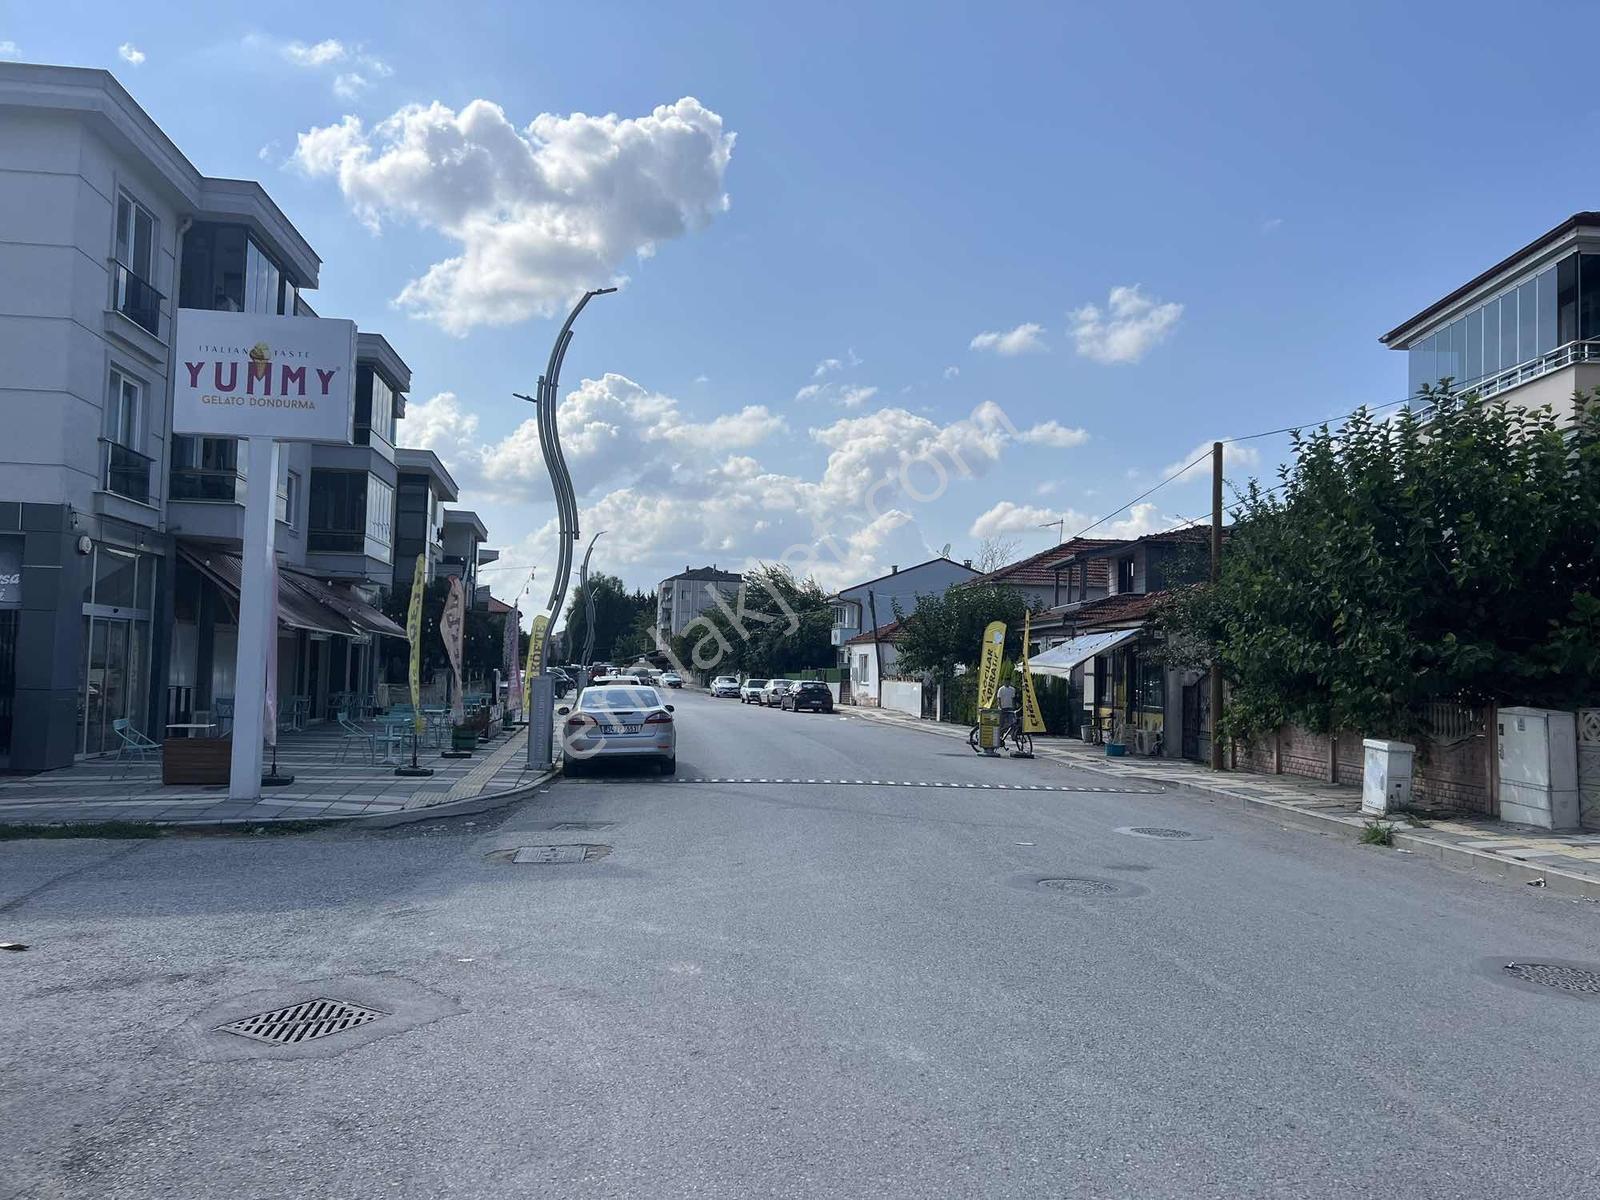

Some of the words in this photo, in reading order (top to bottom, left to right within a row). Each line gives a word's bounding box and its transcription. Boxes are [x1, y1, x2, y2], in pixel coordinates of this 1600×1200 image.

[199, 345, 249, 355] ITALIAN
[274, 350, 311, 359] TASTE
[184, 361, 336, 396] YUMMY
[201, 394, 245, 406] GELATO
[249, 396, 316, 410] DONDURMA
